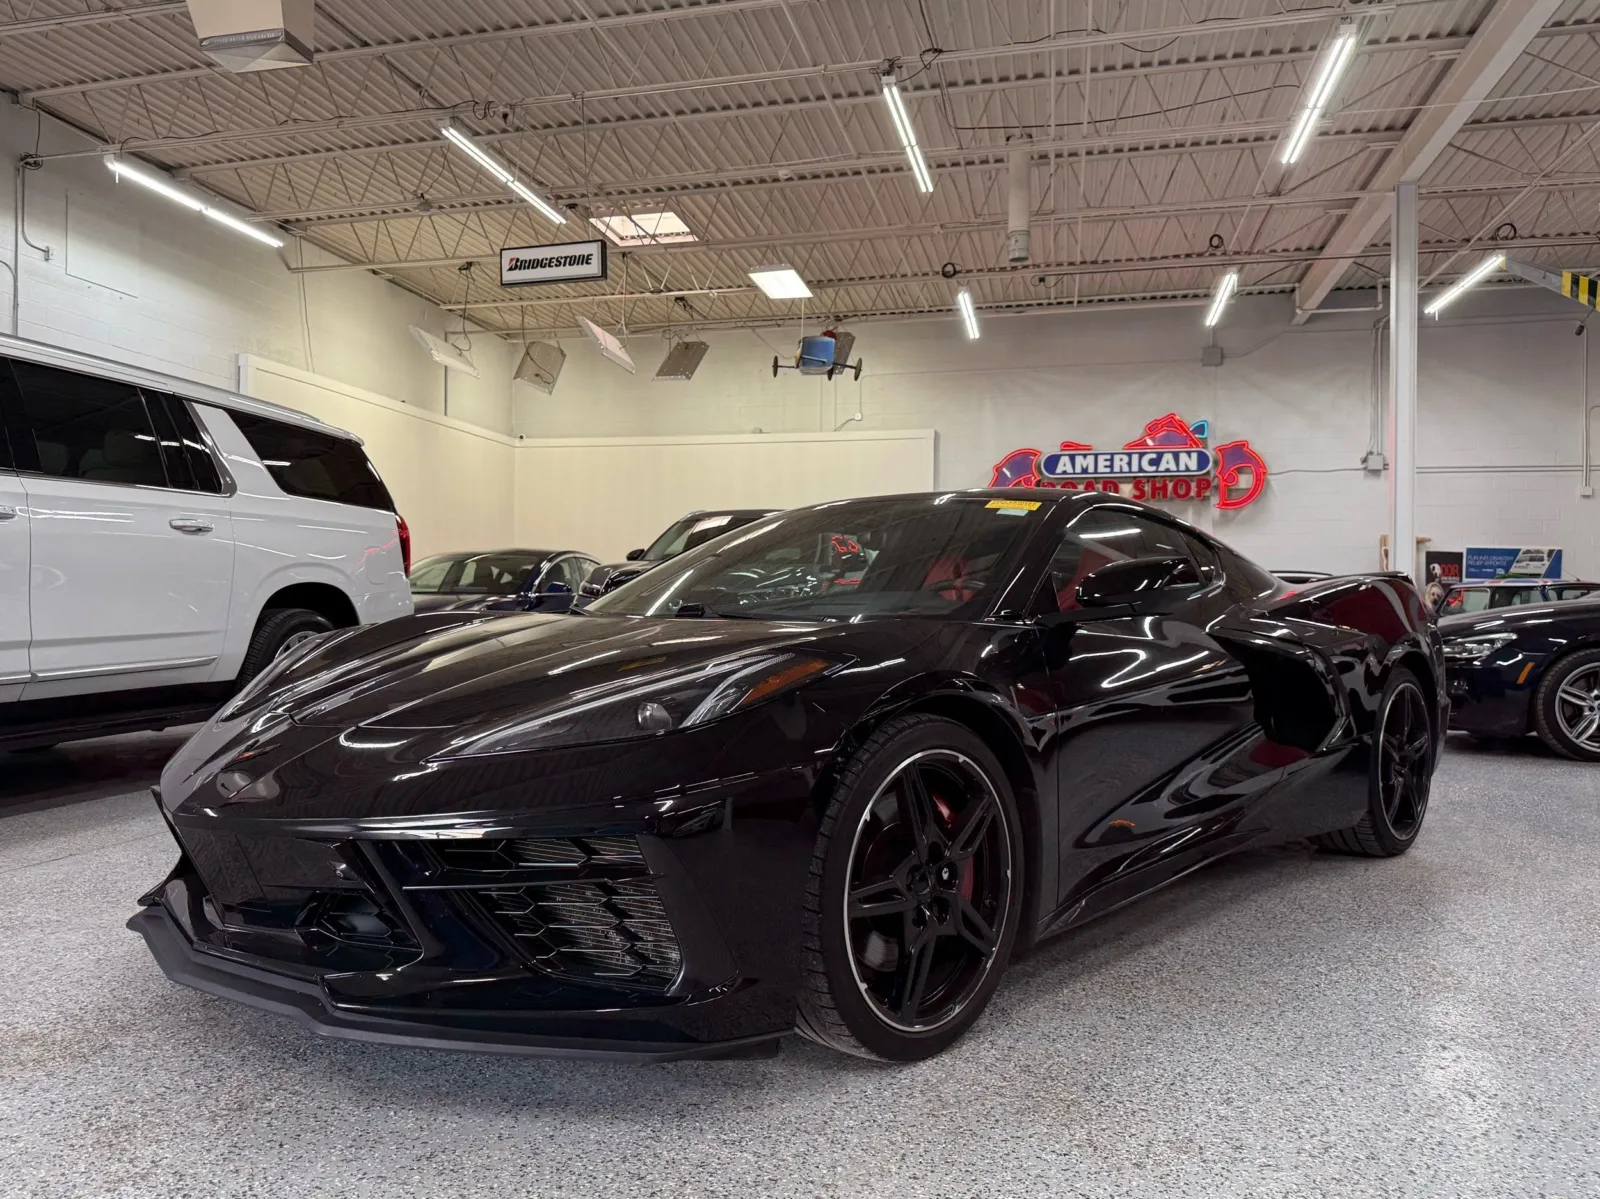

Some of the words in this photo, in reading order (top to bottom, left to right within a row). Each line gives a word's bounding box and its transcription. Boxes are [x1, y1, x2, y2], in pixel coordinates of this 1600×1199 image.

[507, 253, 593, 271] BRIDGESTONE
[1055, 452, 1199, 473] AMERICAN
[1132, 477, 1212, 500] SHOP
